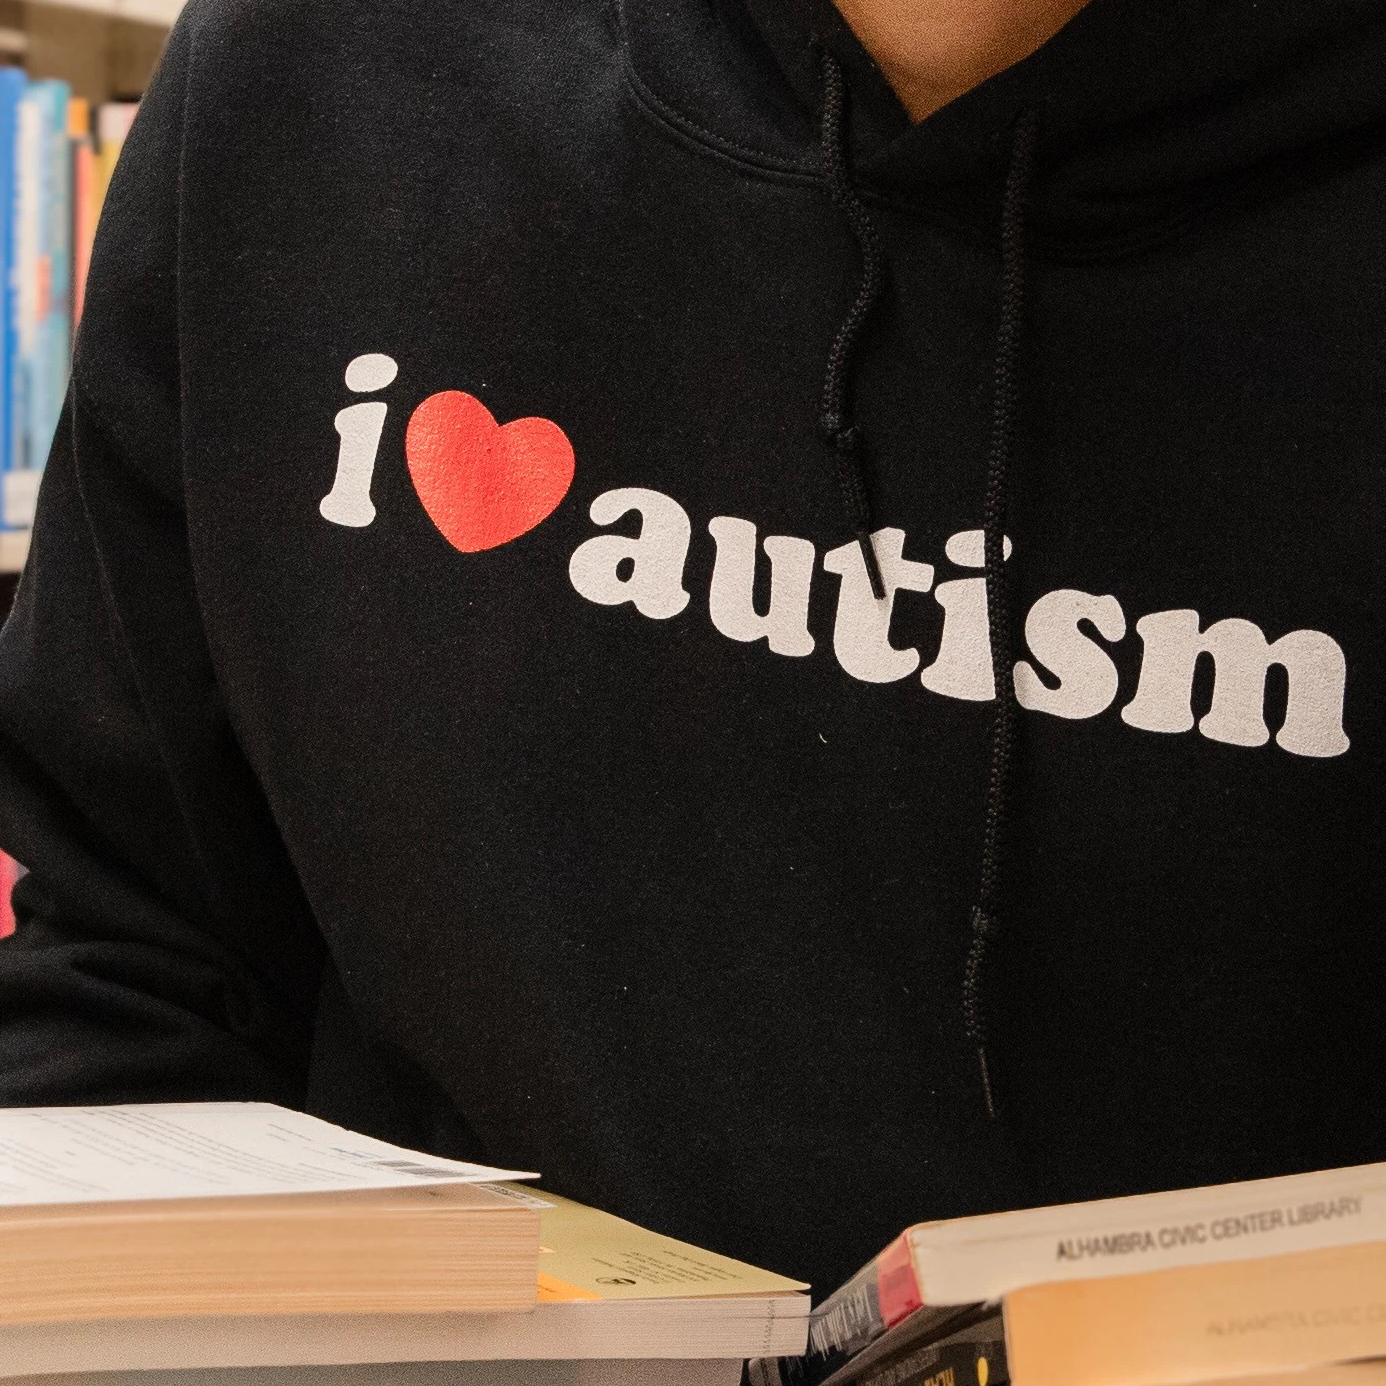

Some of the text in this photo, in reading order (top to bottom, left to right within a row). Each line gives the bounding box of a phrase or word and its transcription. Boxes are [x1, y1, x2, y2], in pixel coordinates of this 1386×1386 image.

[318, 352, 399, 528] i
[567, 485, 1352, 759] autism
[1056, 1193, 1362, 1263] ALHAMBRA CIVIC CENTER LIBRARY
